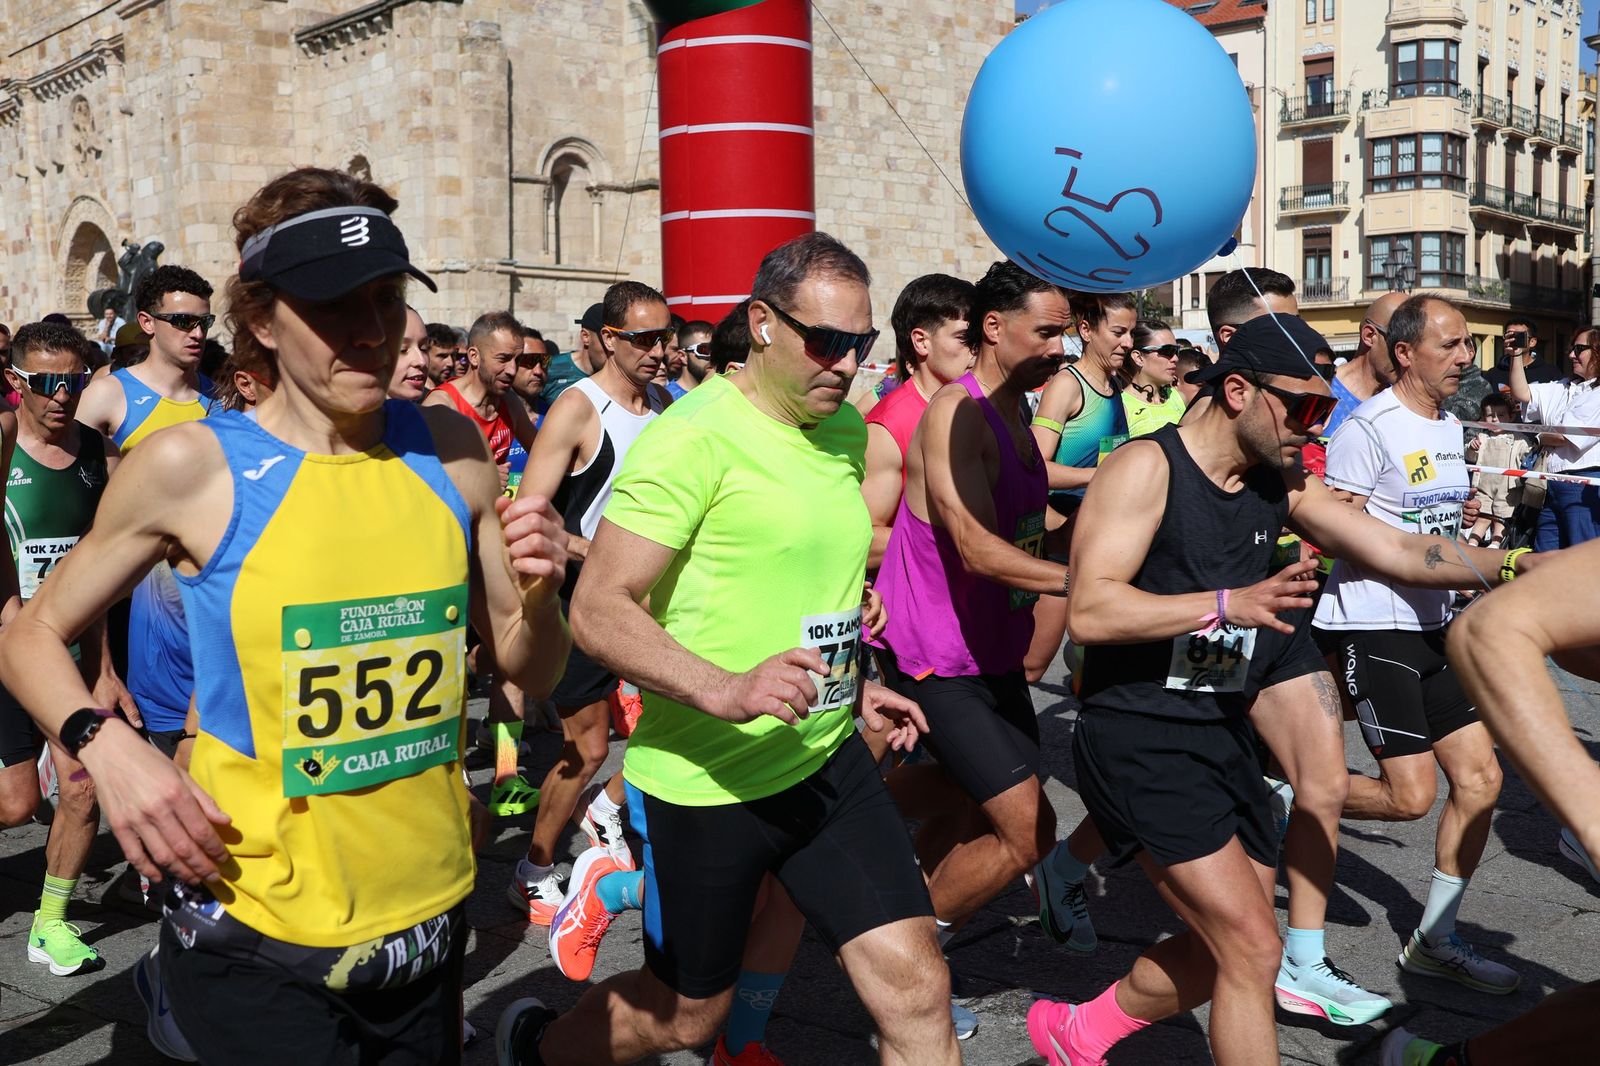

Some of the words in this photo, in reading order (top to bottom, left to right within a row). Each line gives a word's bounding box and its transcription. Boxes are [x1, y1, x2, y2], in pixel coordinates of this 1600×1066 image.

[24, 544, 47, 555] 10K
[340, 619, 374, 634] CAJA
[378, 612, 425, 629] RURAL
[808, 624, 834, 640] 10K
[341, 635, 352, 643] DE
[354, 630, 387, 642] ZAMORA
[1186, 633, 1245, 665] 814
[297, 649, 443, 739] 552
[343, 753, 391, 774] CAJA
[394, 733, 451, 764] RURAL
